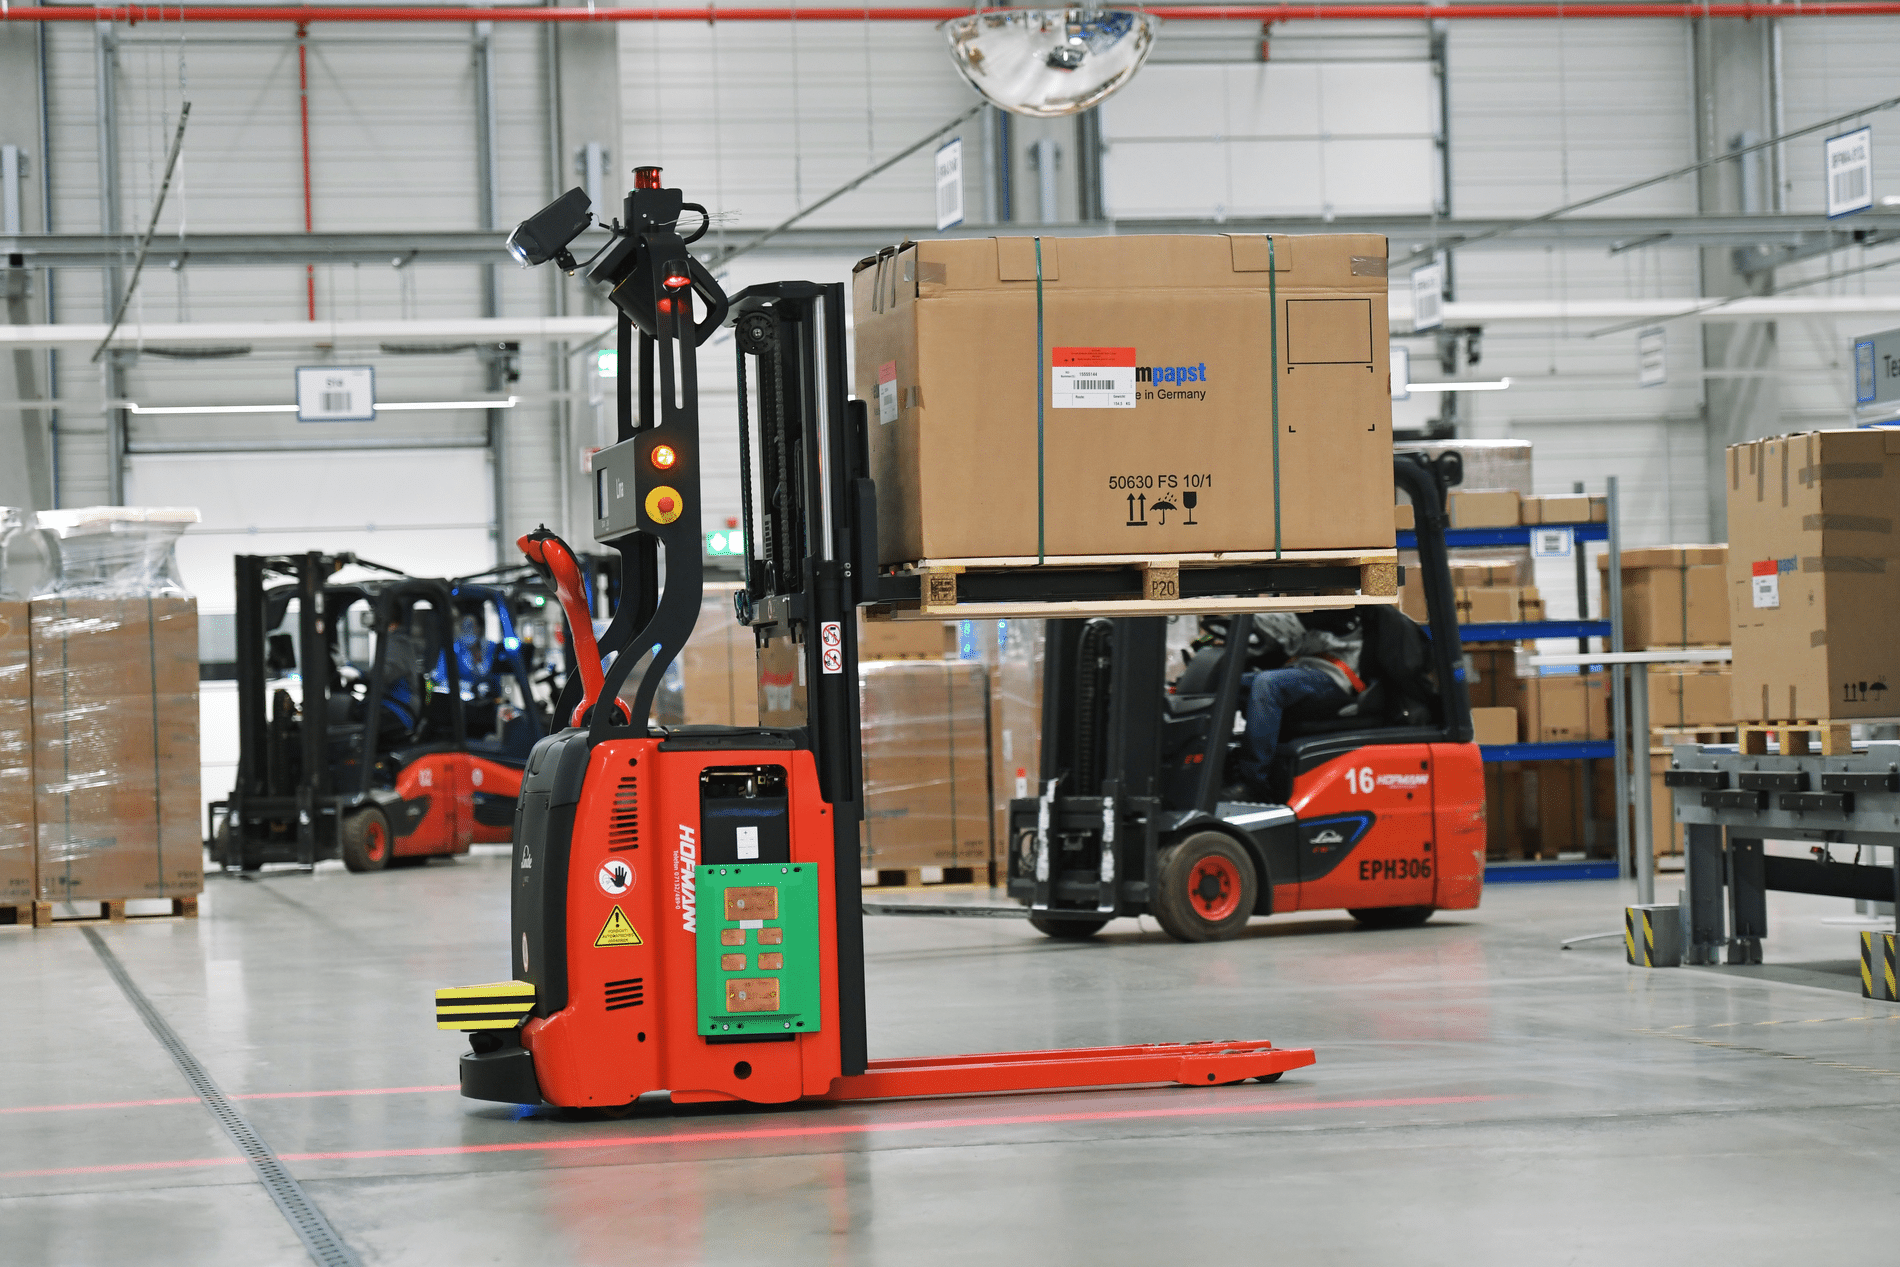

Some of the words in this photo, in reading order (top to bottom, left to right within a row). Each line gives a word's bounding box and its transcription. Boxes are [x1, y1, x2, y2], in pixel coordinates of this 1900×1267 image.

[1144, 389, 1154, 400] in
[1157, 389, 1206, 401] Germany
[1108, 475, 1153, 489] 50630
[1158, 474, 1178, 488] FS
[1183, 474, 1212, 488] 10/1
[1152, 580, 1175, 596] P20
[1344, 766, 1375, 795] 16
[679, 823, 697, 934] HOFMANN
[1360, 858, 1431, 880] EPH306
